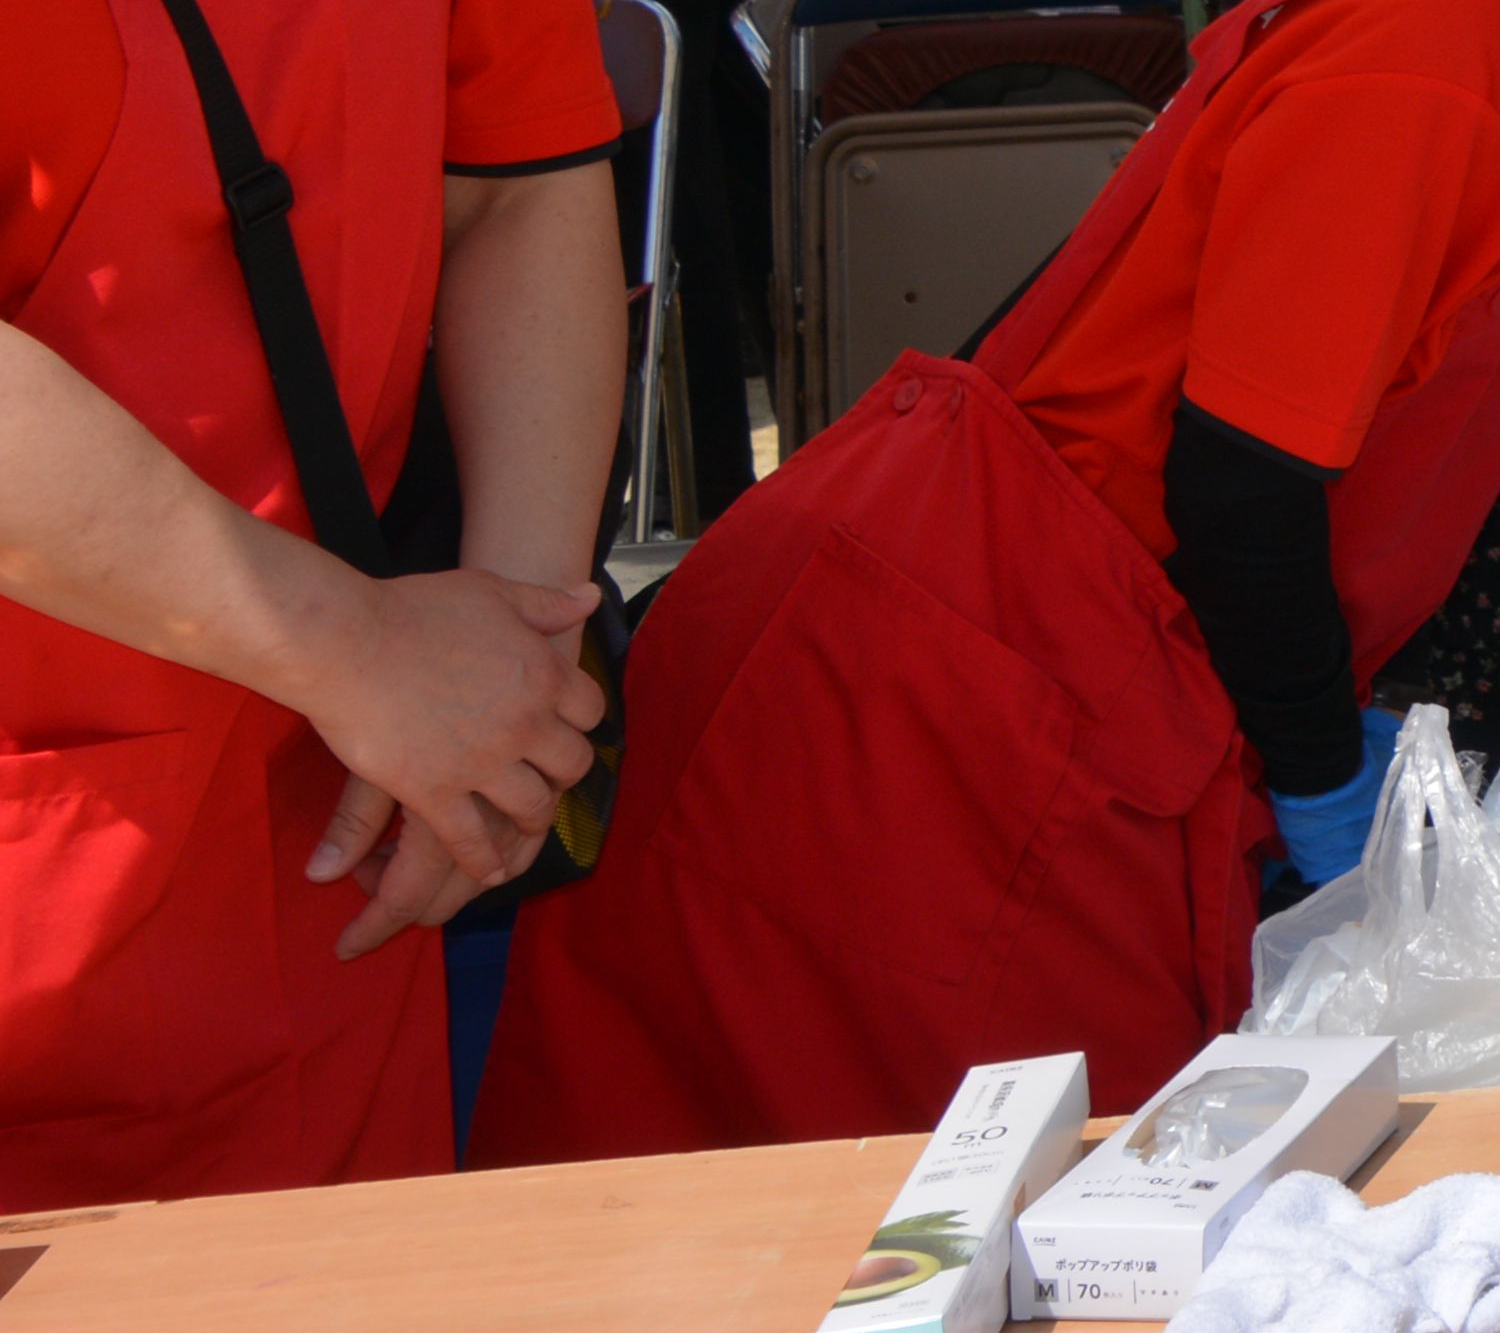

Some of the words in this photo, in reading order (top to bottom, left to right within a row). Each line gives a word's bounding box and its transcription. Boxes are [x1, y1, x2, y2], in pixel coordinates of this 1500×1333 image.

[951, 1125, 1009, 1146] 50
[1055, 1258, 1158, 1273] ポップアップポリ袋
